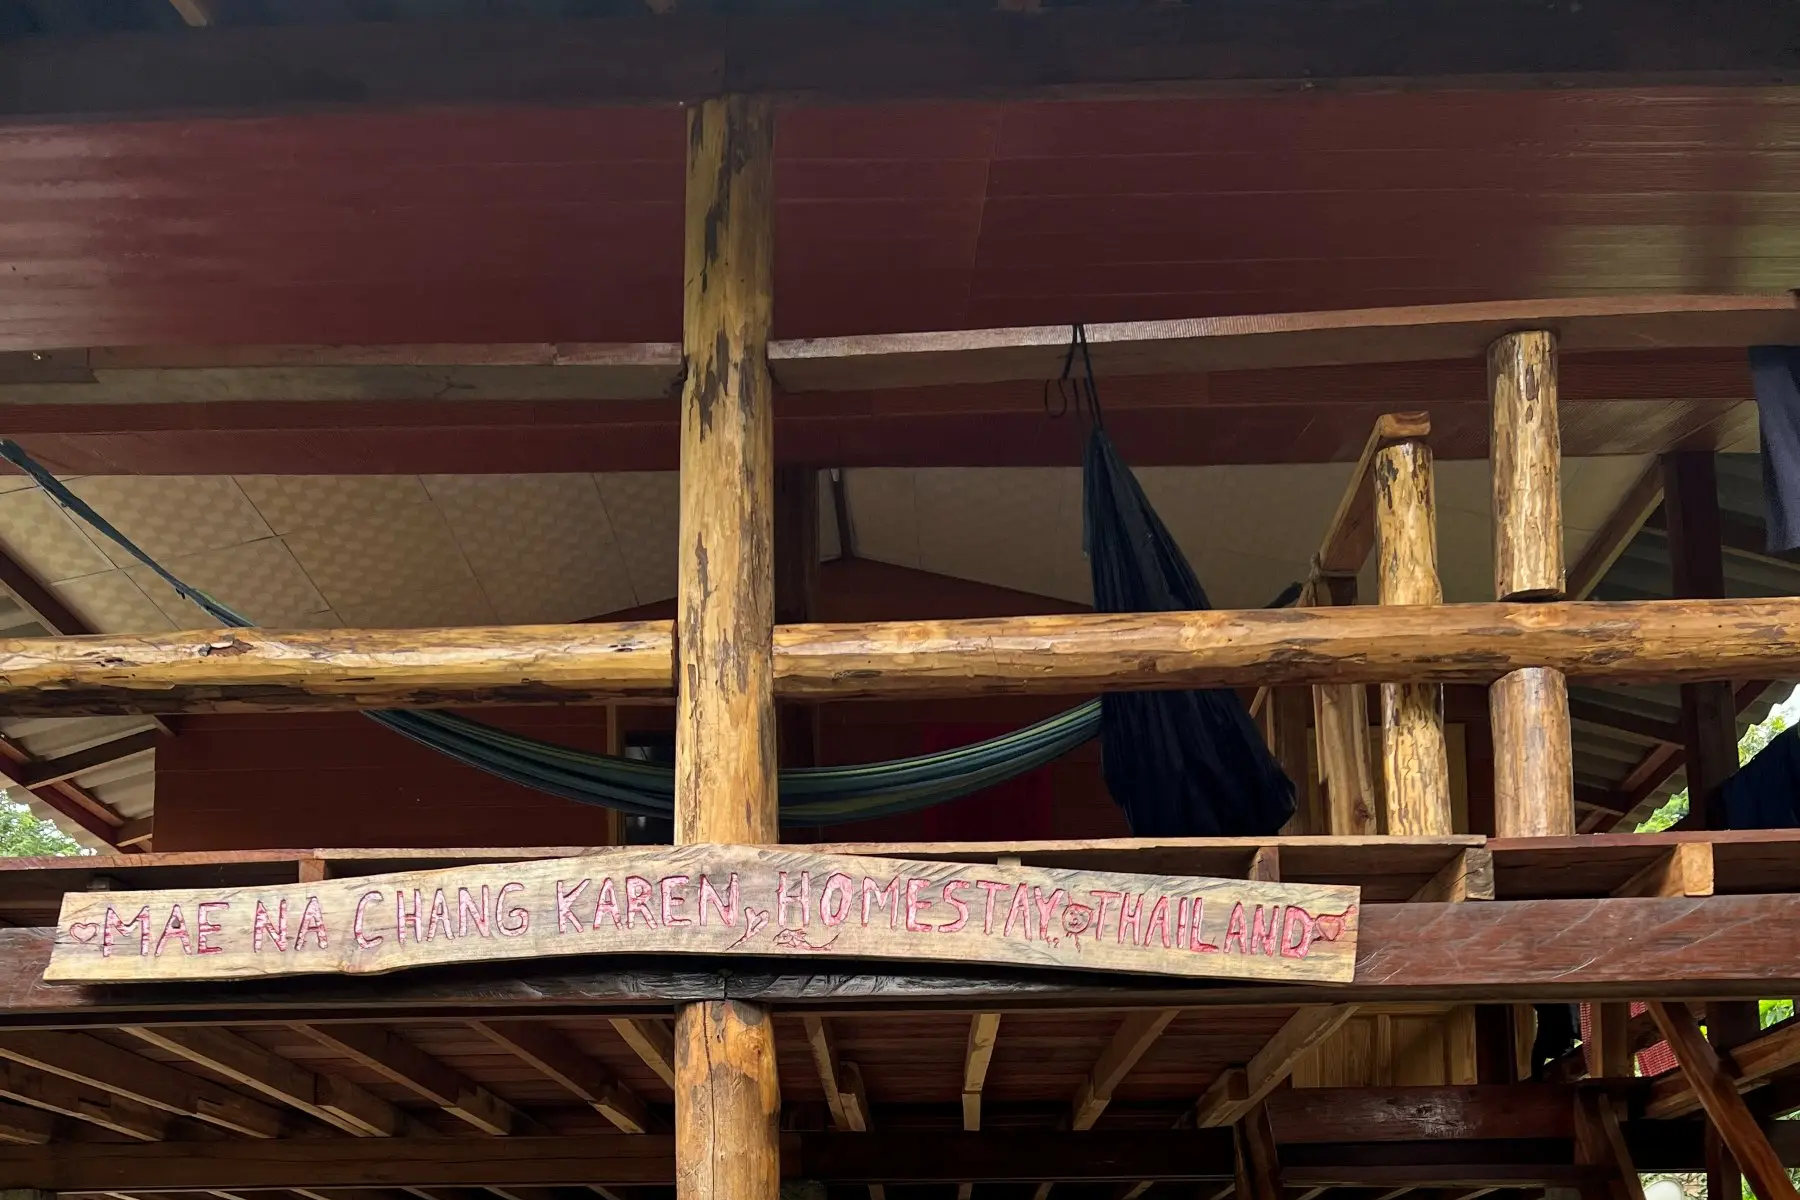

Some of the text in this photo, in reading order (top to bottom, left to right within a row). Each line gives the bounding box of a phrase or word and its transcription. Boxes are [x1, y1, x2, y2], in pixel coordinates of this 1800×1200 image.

[102, 871, 1313, 959] MAE NA CHANG KAREN HOMESTAY THAILAND
